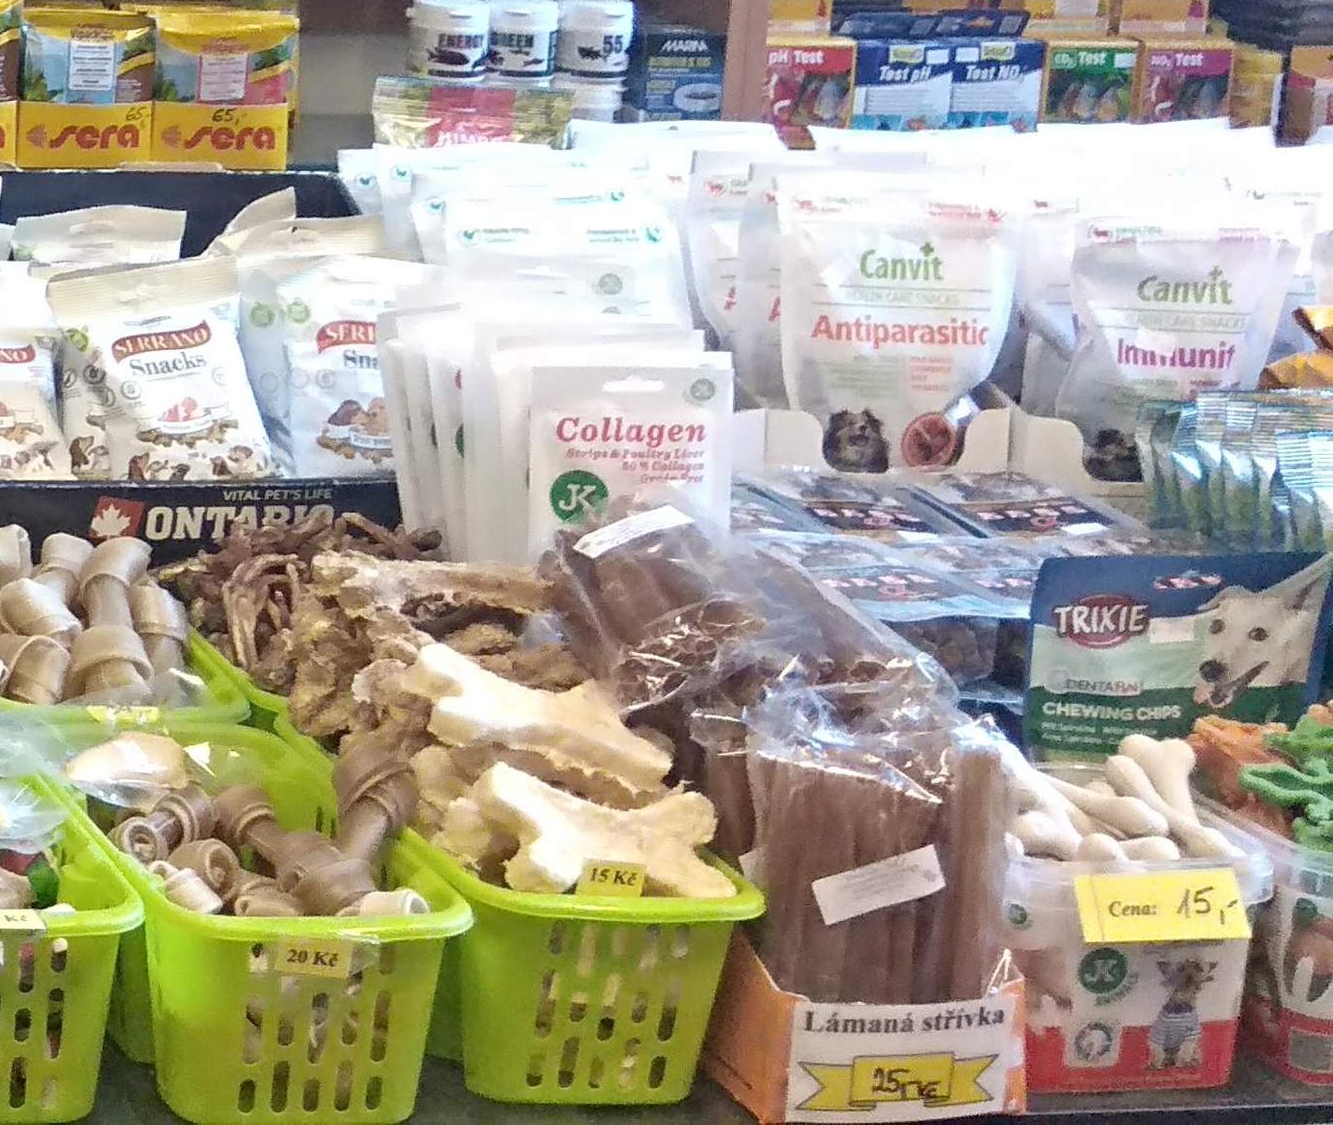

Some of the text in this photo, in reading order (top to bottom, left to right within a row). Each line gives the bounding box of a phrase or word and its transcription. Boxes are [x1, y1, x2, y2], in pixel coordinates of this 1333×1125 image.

[603, 36, 623, 55] 55
[794, 49, 824, 66] Test
[1079, 51, 1107, 66] Test
[1175, 52, 1203, 67] Test
[879, 65, 932, 84] Test pH
[965, 63, 997, 80] Test
[49, 123, 140, 149] sera
[184, 125, 276, 151] sera
[860, 243, 943, 282] Canvit
[1138, 268, 1233, 306] Canvit
[113, 324, 211, 362] SERRANO
[811, 315, 989, 350] Antiparasitic
[130, 351, 207, 376] Snacks
[556, 418, 706, 445] Collagen
[224, 489, 333, 503] VITAL PET'S LIFE
[559, 482, 596, 511] JK
[1055, 603, 1150, 635] TRIXIE
[1042, 701, 1182, 721] CHEWING CHIPS
[589, 864, 639, 886] 15 Kč
[1108, 899, 1158, 918] Cena:
[285, 947, 340, 969] 20 Kč
[805, 1004, 1007, 1034] Lámaná střívka
